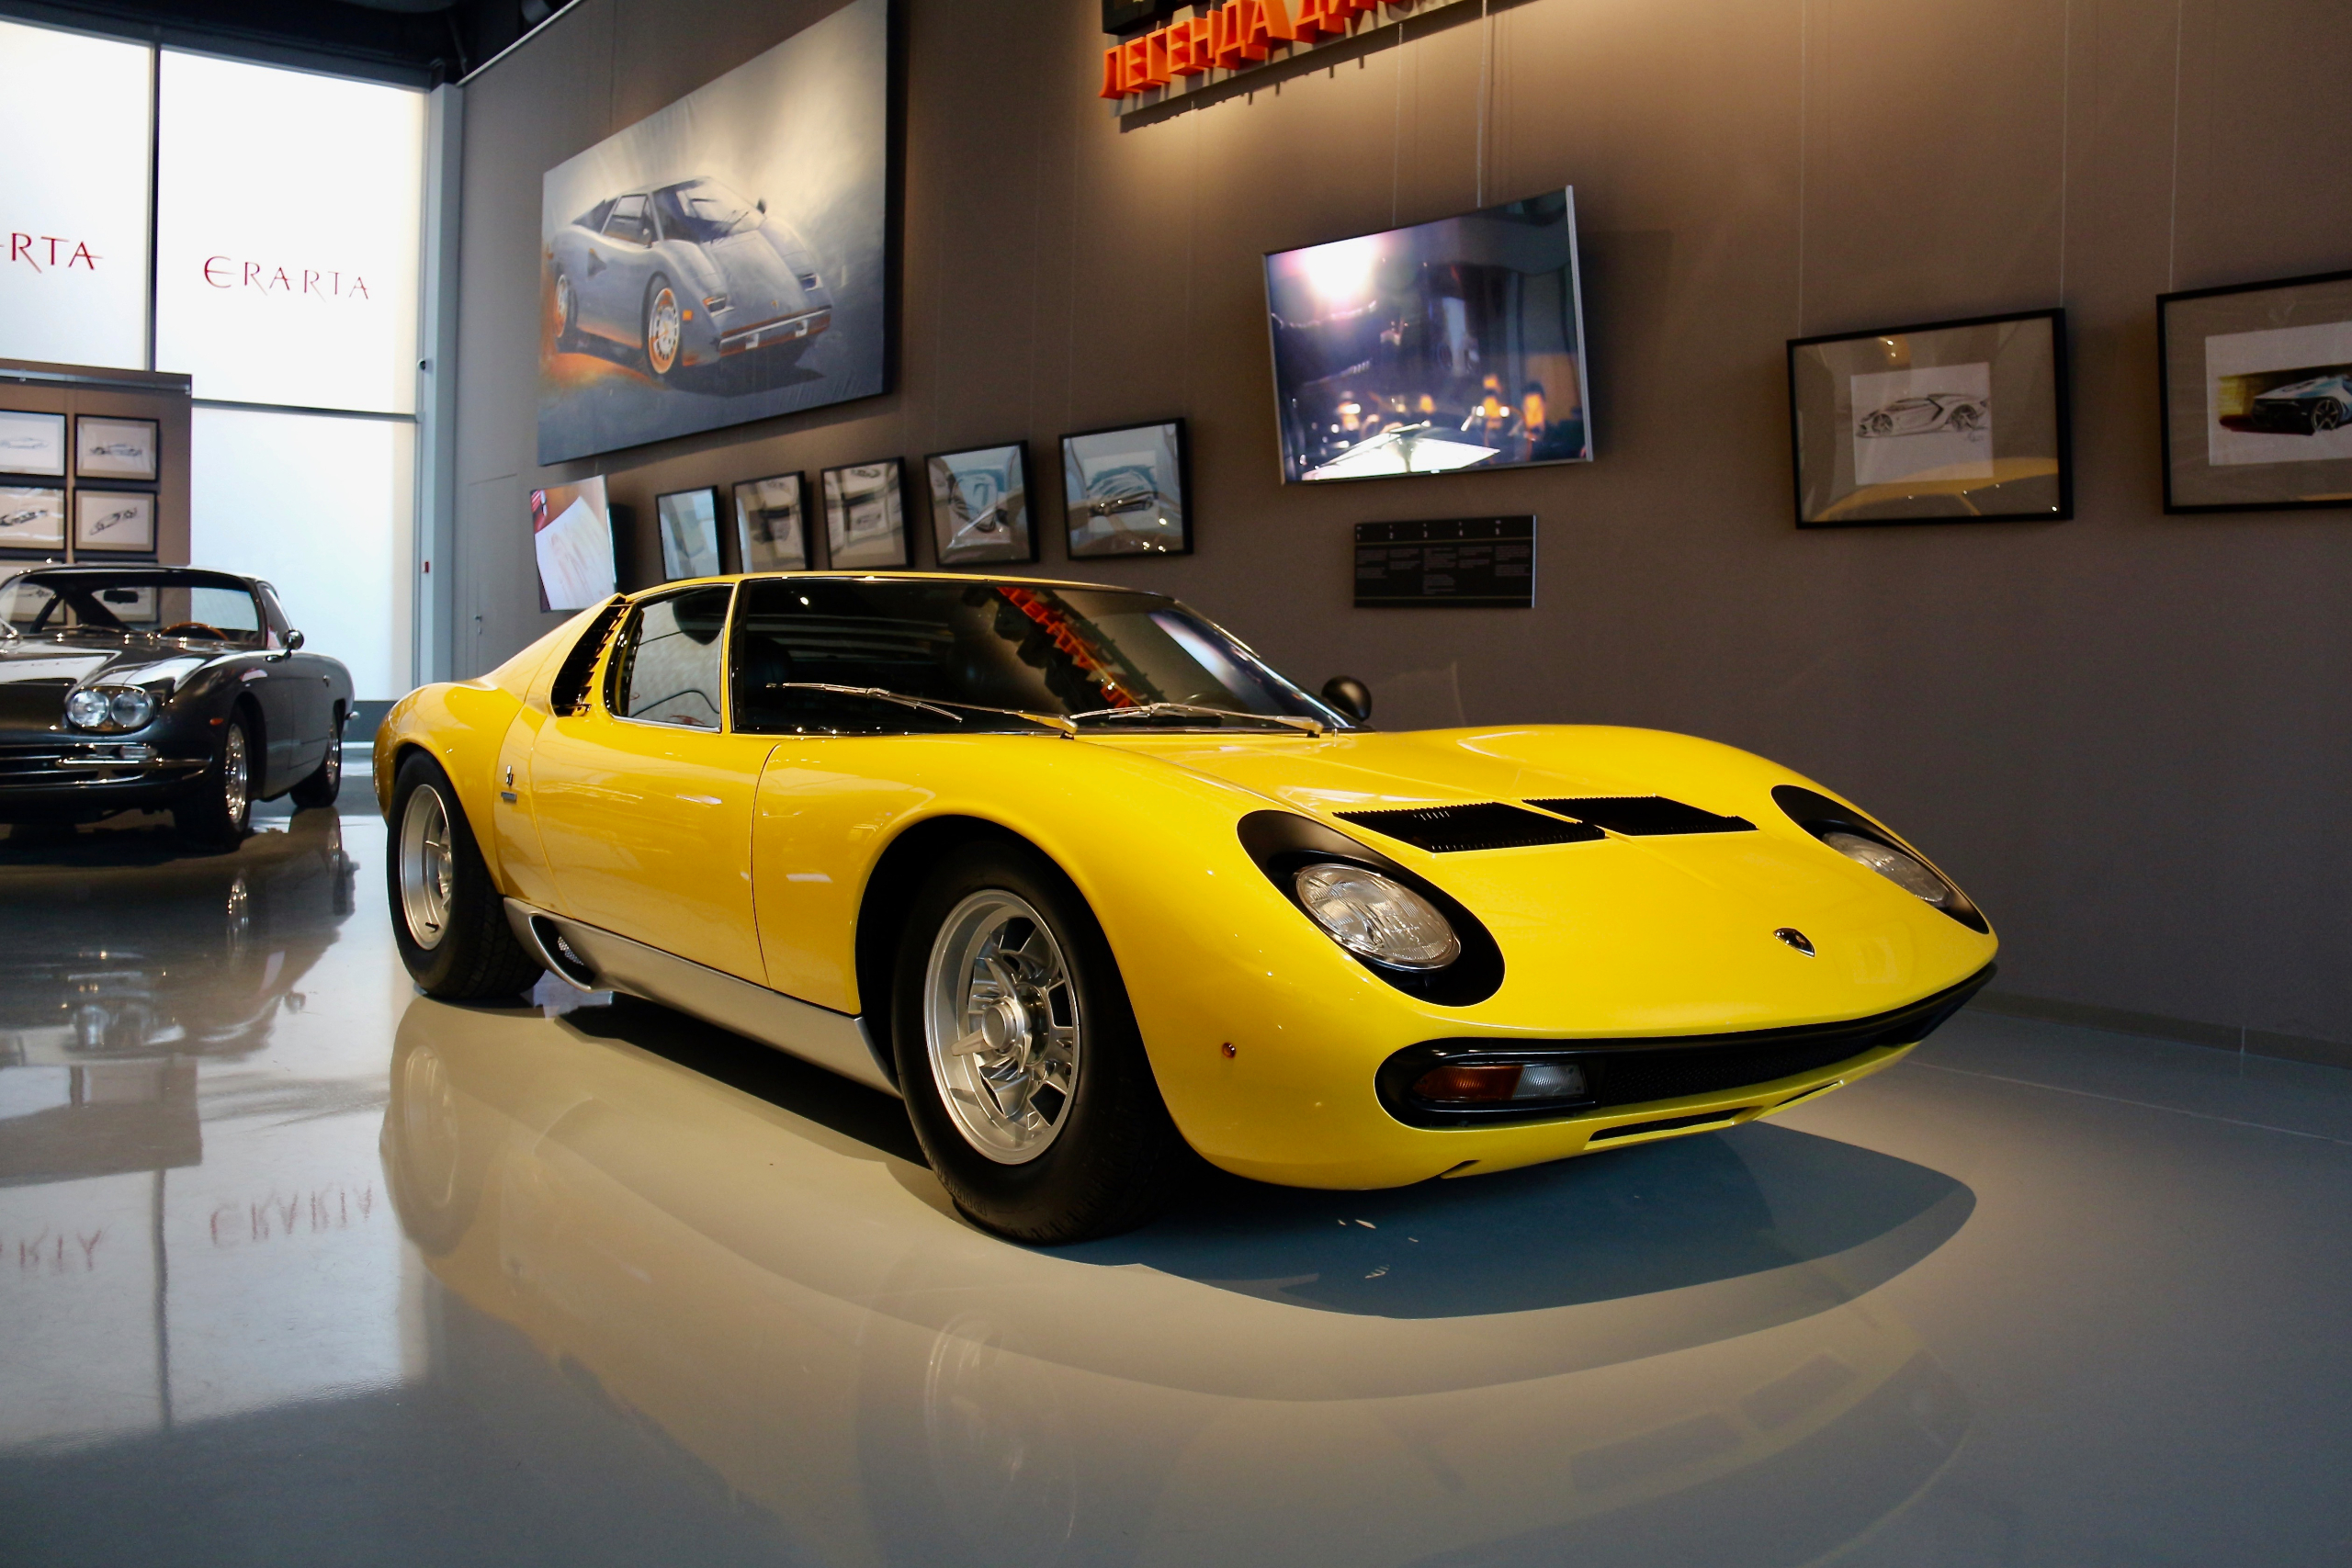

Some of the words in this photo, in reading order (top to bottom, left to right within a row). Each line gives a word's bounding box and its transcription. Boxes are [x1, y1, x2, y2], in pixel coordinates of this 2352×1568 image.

[1099, 0, 1293, 99] ЛЕГЕНДА
[0, 232, 103, 274] RTA
[203, 254, 371, 303] ERARTA
